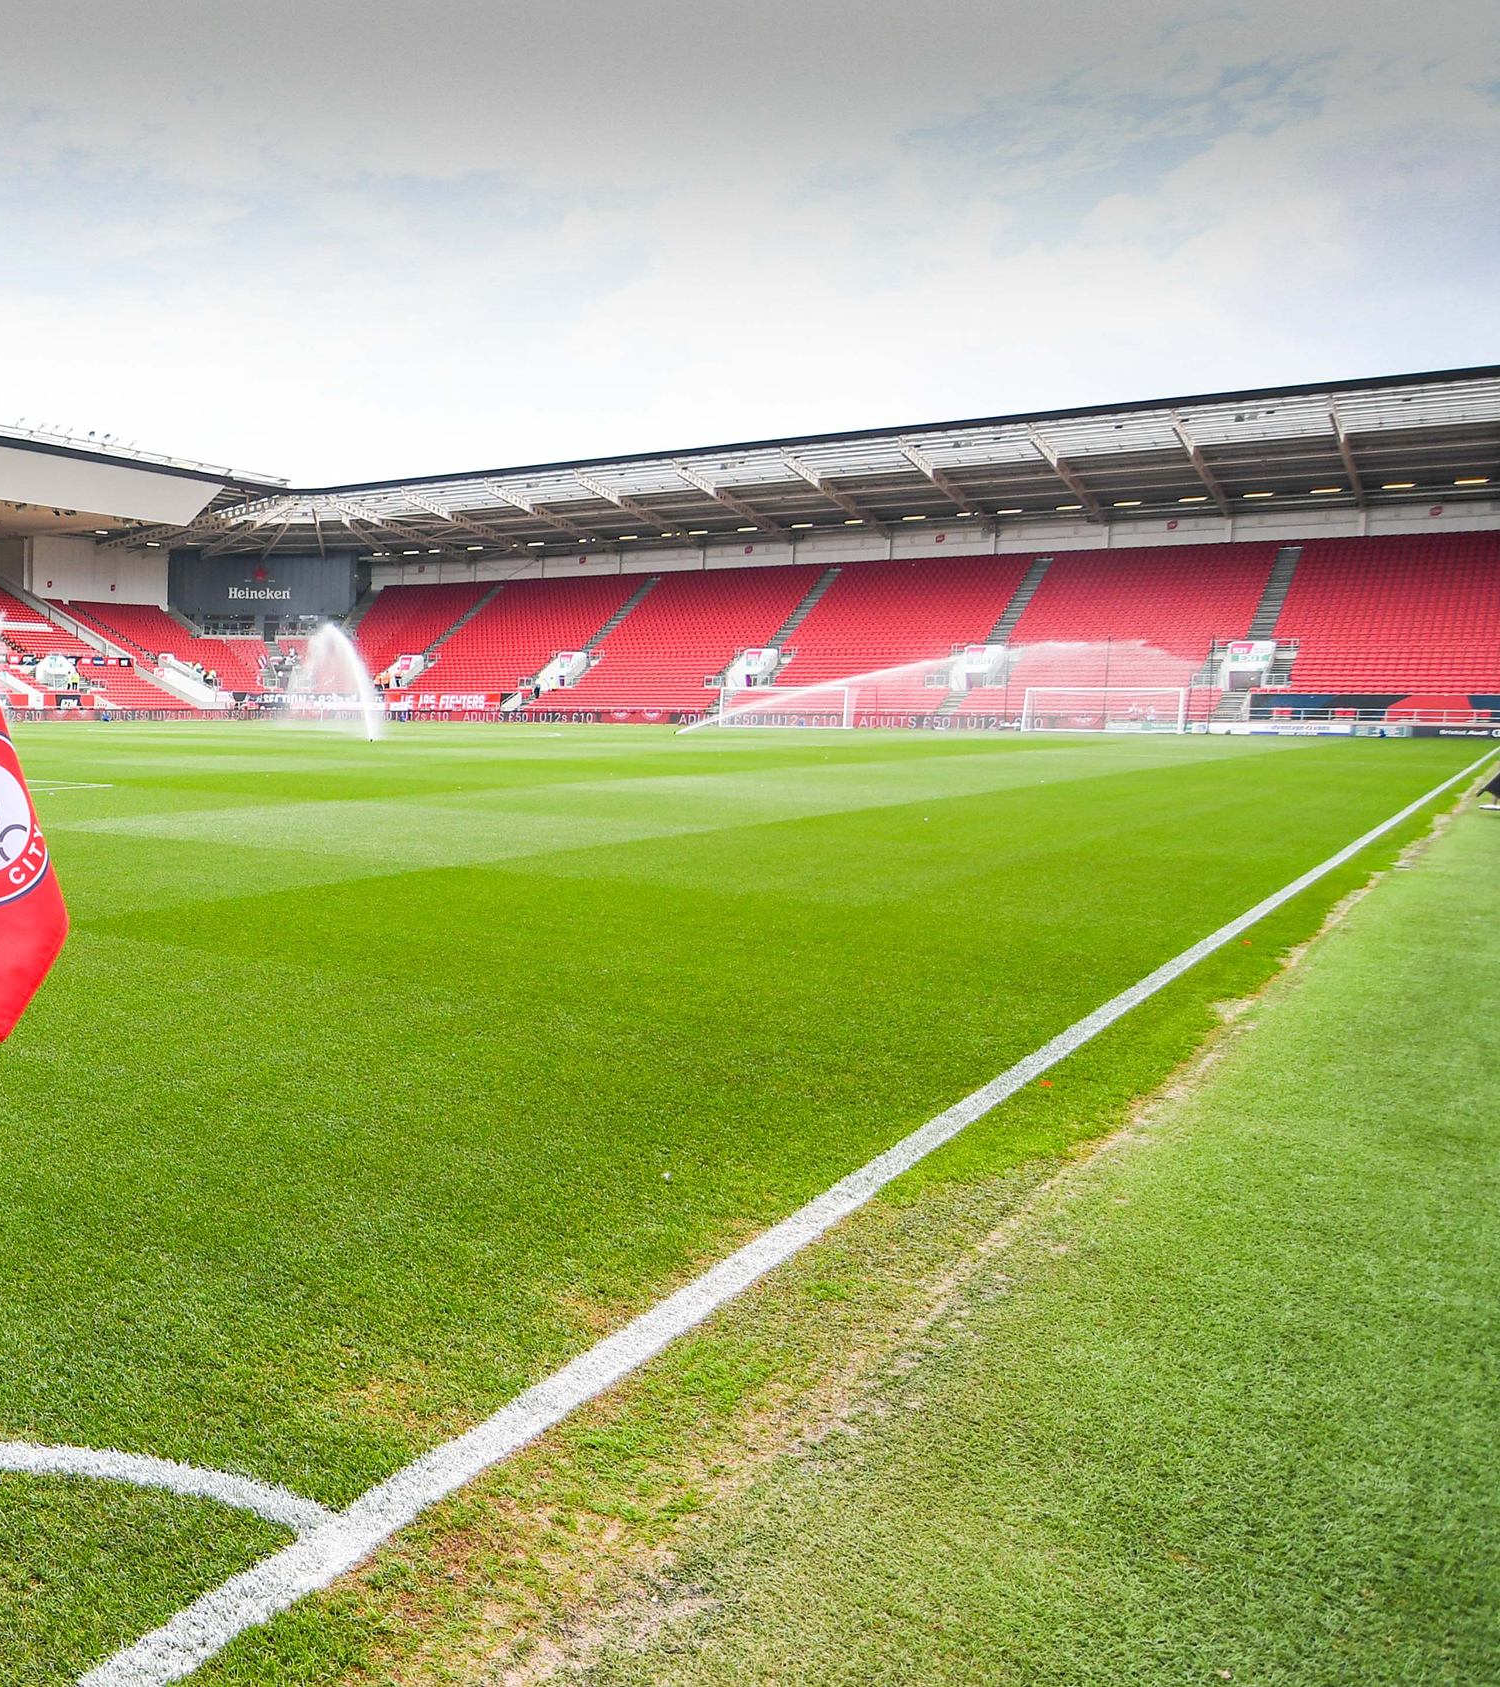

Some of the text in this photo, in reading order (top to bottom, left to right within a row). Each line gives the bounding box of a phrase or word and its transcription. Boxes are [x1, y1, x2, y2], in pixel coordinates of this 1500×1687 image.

[228, 587, 290, 599] Heineken
[24, 710, 42, 721] £10
[134, 710, 150, 720] £50
[156, 710, 176, 720] U12s
[177, 710, 192, 720] £10
[201, 710, 230, 720] ADULTS
[231, 710, 245, 720] £50
[430, 711, 449, 721] £10
[462, 711, 593, 723] ADULTS £50 U12s £10
[734, 715, 758, 726] £50
[812, 715, 838, 727] £10
[859, 716, 917, 728] ADULTS
[922, 716, 950, 729] £50
[9, 824, 44, 884] CITY
